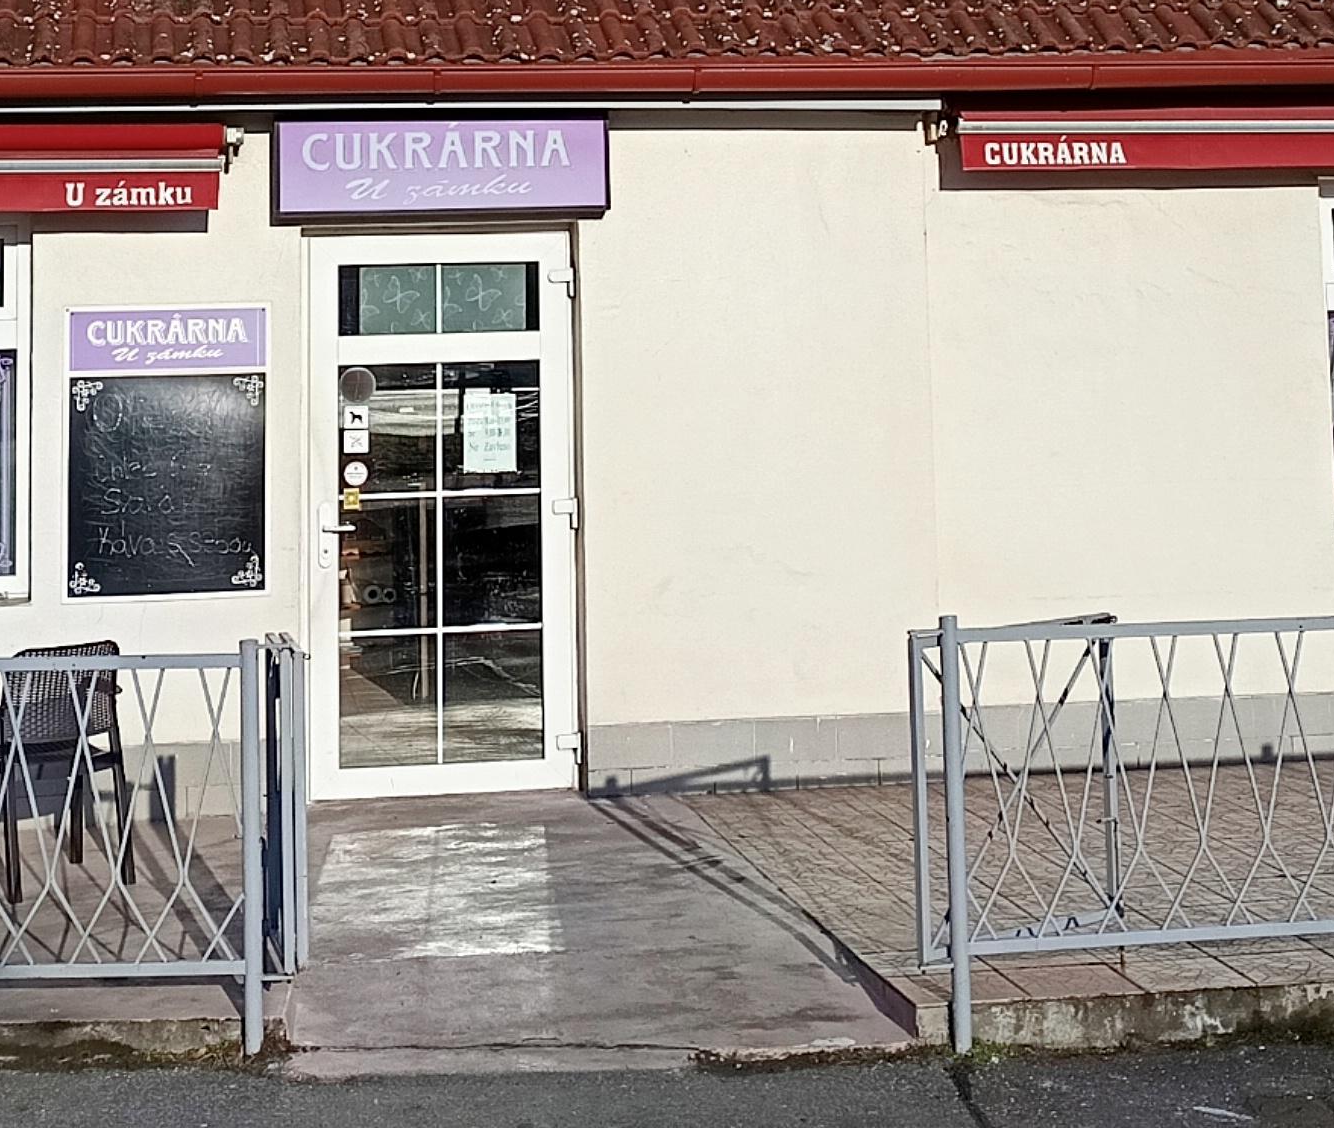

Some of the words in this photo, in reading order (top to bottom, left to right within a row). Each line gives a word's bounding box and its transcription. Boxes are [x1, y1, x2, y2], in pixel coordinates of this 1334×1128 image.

[301, 122, 572, 171] CUKRÁRNA
[984, 134, 1128, 165] CUKRÁRNA
[65, 182, 85, 207] U
[94, 180, 193, 207] zámku
[345, 178, 388, 200] U
[402, 174, 533, 206] zámku
[86, 313, 249, 346] CUKRÁRNA
[111, 346, 140, 362] U
[144, 344, 225, 365] zámku
